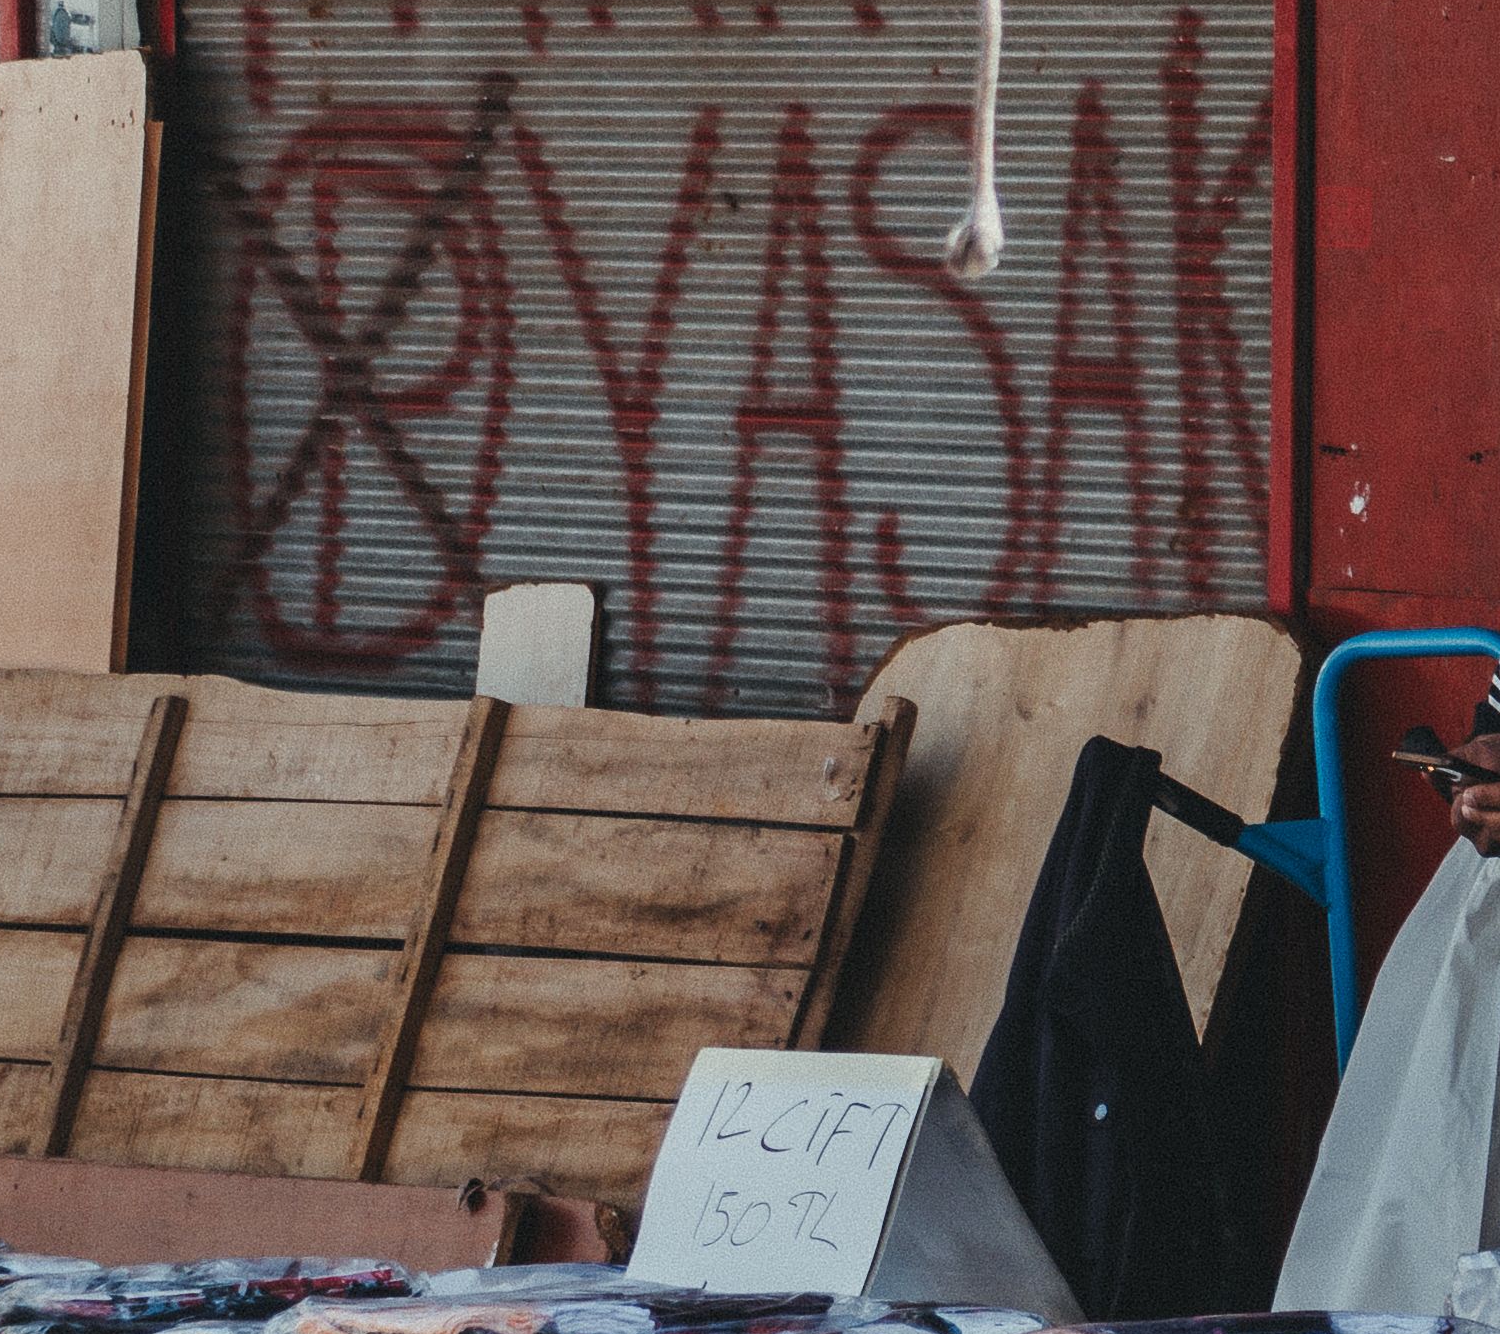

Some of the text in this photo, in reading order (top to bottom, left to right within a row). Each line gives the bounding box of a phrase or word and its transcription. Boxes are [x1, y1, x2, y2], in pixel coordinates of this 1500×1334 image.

[697, 1078, 753, 1147] 12
[693, 1180, 839, 1251] 150 TL
